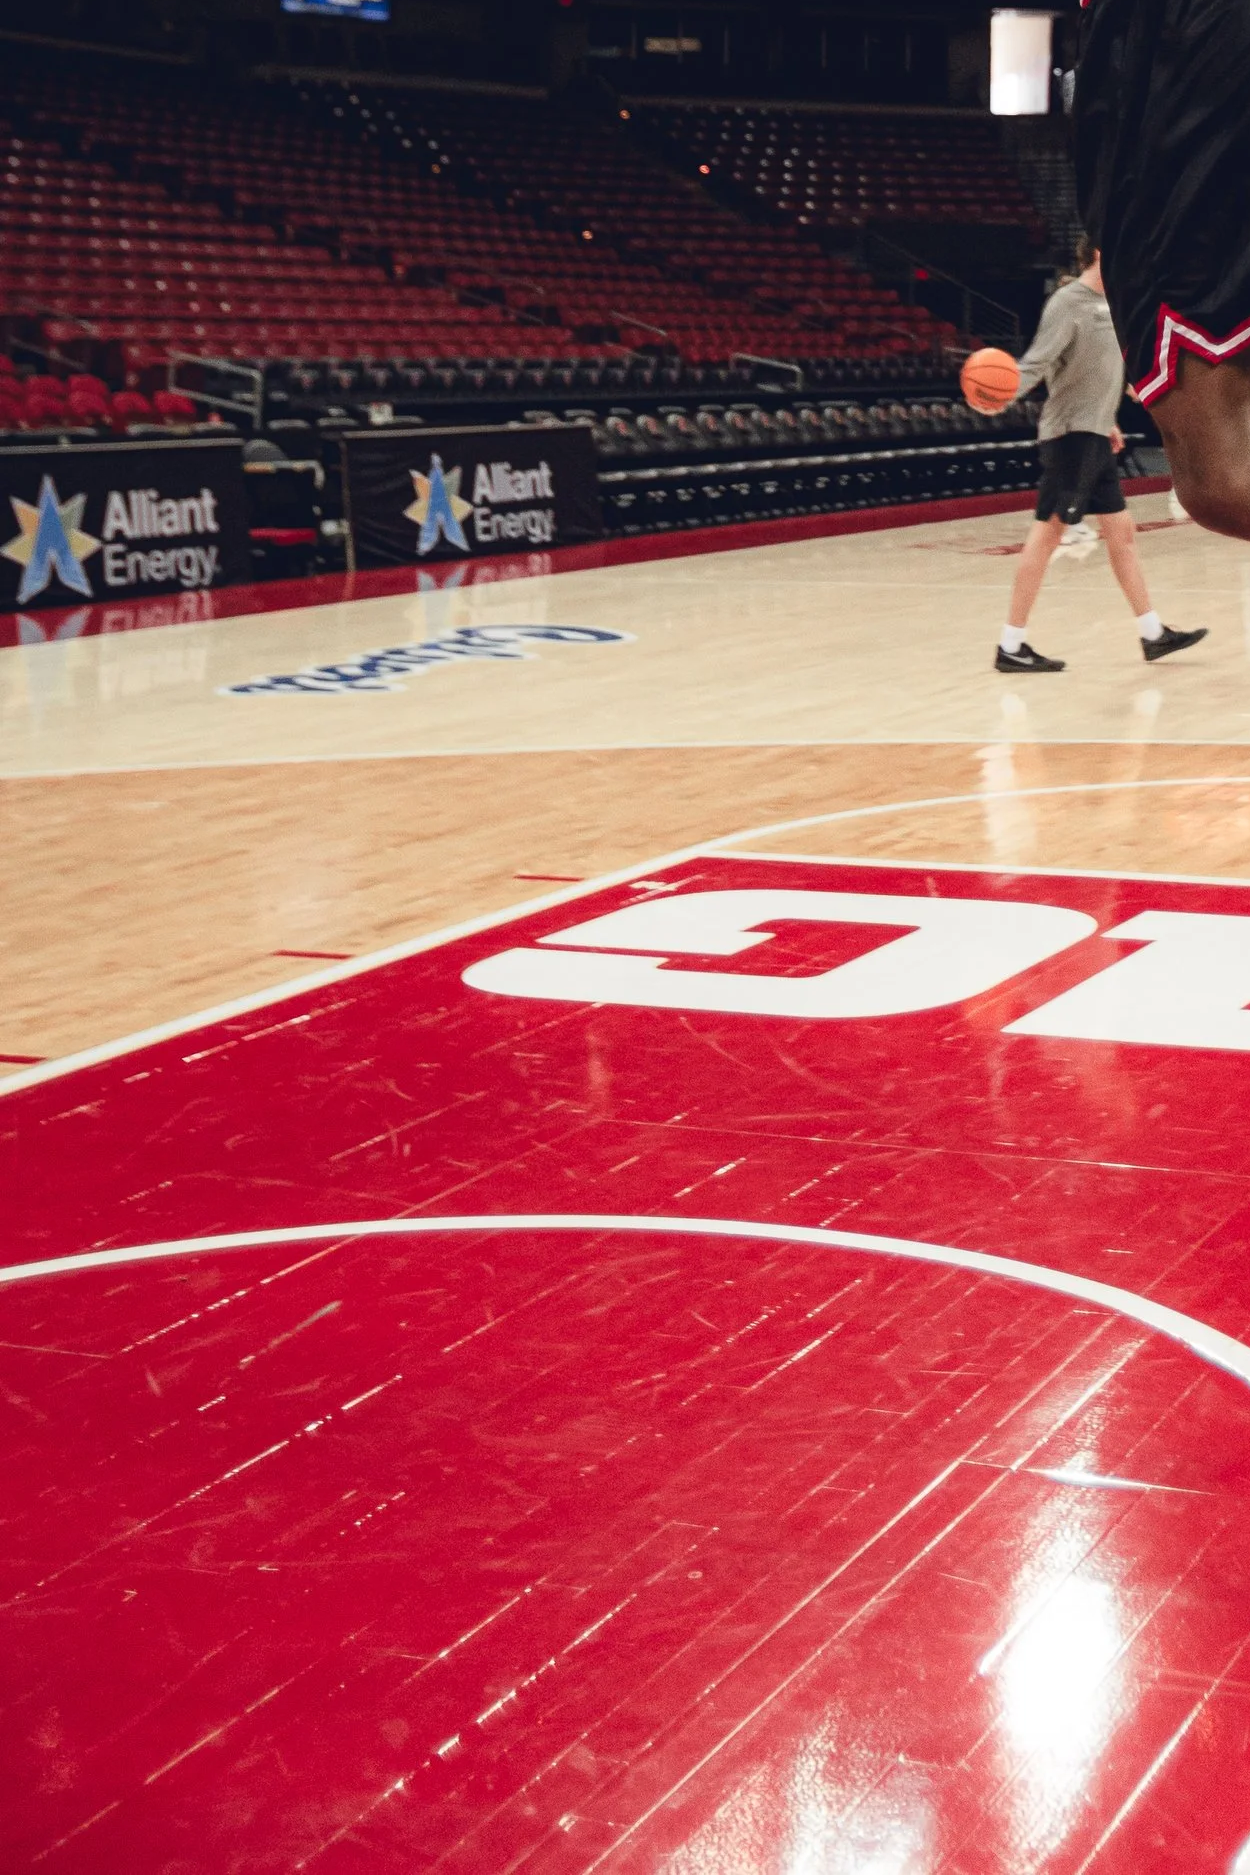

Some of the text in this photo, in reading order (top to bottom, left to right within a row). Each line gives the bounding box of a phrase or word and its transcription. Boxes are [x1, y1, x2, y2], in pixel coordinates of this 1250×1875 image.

[473, 461, 555, 504] Alliant
[104, 487, 220, 541] Alliant
[473, 508, 554, 543] Energy
[104, 543, 219, 588] Energy
